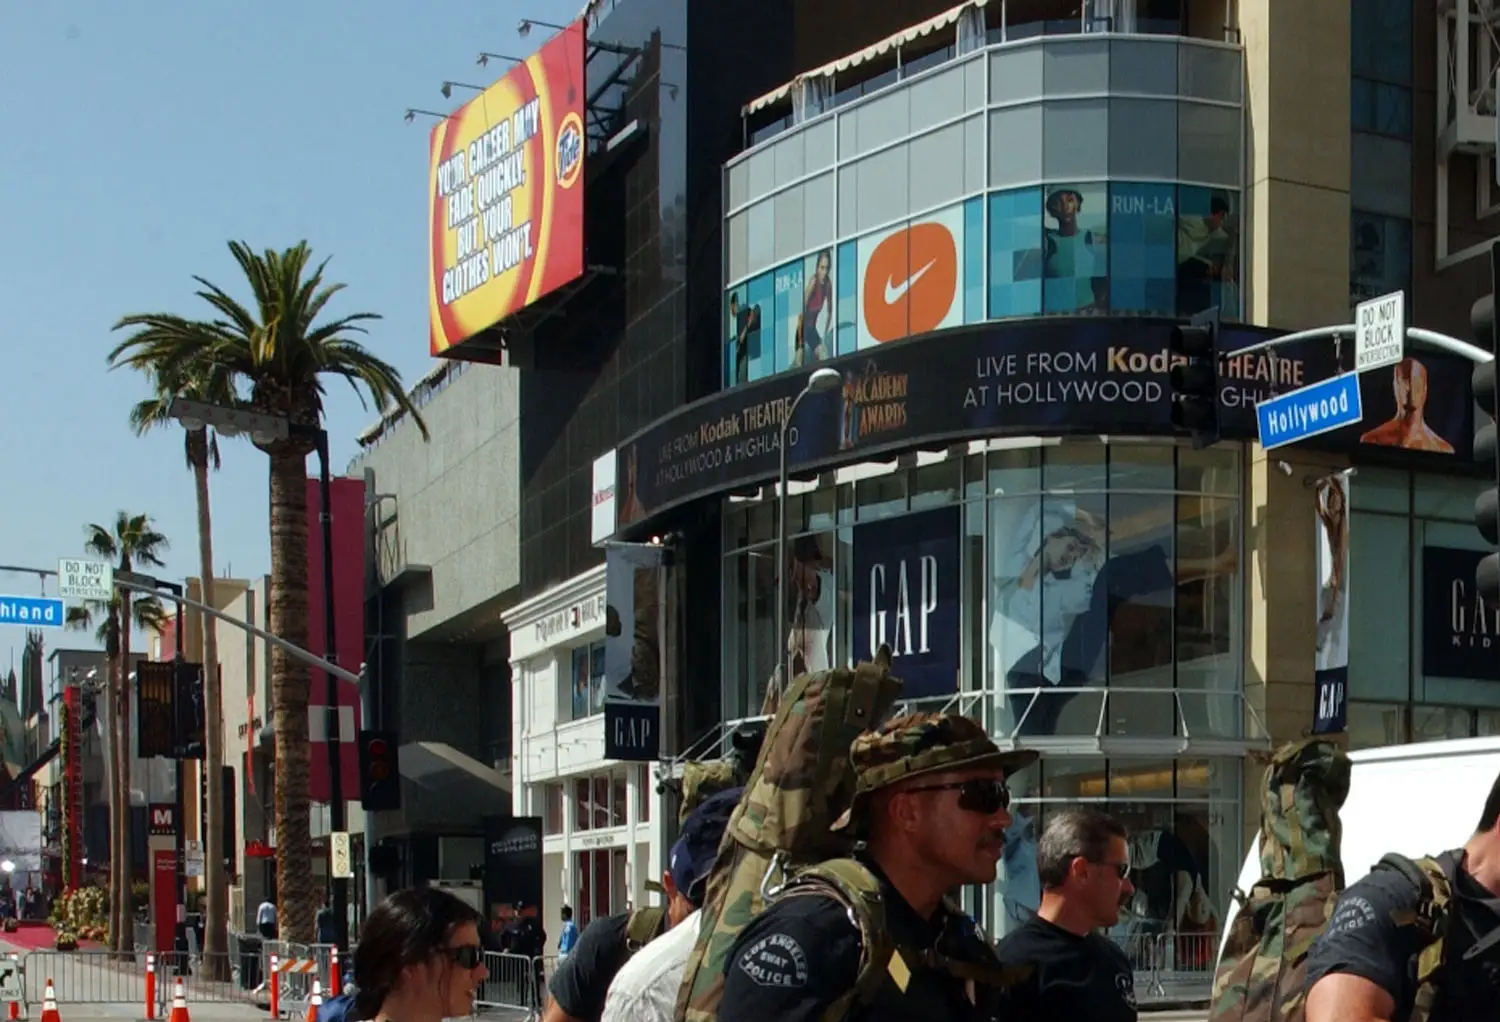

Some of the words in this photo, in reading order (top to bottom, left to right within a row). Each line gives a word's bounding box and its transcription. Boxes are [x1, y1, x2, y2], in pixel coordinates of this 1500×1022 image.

[437, 149, 466, 198] YOUR
[468, 117, 511, 179] CAREER
[513, 95, 540, 149] MAY
[448, 182, 474, 231] FADE
[477, 147, 526, 212] QUICKLY,
[1112, 194, 1174, 215] RUN-LA
[456, 217, 479, 263] BUT
[481, 195, 513, 243] YOUR
[443, 247, 489, 305] CLOTHES
[1362, 307, 1374, 328] DO
[1379, 300, 1397, 321] NOT
[1364, 324, 1394, 349] BLOCK
[977, 354, 1016, 379] LIVE
[1026, 351, 1097, 374] FROM
[1107, 346, 1190, 373] Koda
[963, 384, 989, 408] AT
[997, 381, 1162, 406] HOLLYWOOD
[700, 413, 740, 446] Kodak
[743, 396, 791, 433] THEATRE
[1267, 387, 1349, 436] Hollywood
[734, 427, 799, 460] HIGHLAD
[65, 562, 79, 573] DO
[85, 563, 104, 575] NOT
[68, 574, 102, 586] BLOCK
[0, 602, 54, 620] hland
[870, 555, 938, 661] GAP
[1452, 578, 1500, 634] GA
[1319, 681, 1344, 720] GAP
[614, 716, 651, 748] GAP
[743, 939, 767, 961] LOS
[745, 961, 793, 986] POLICE
